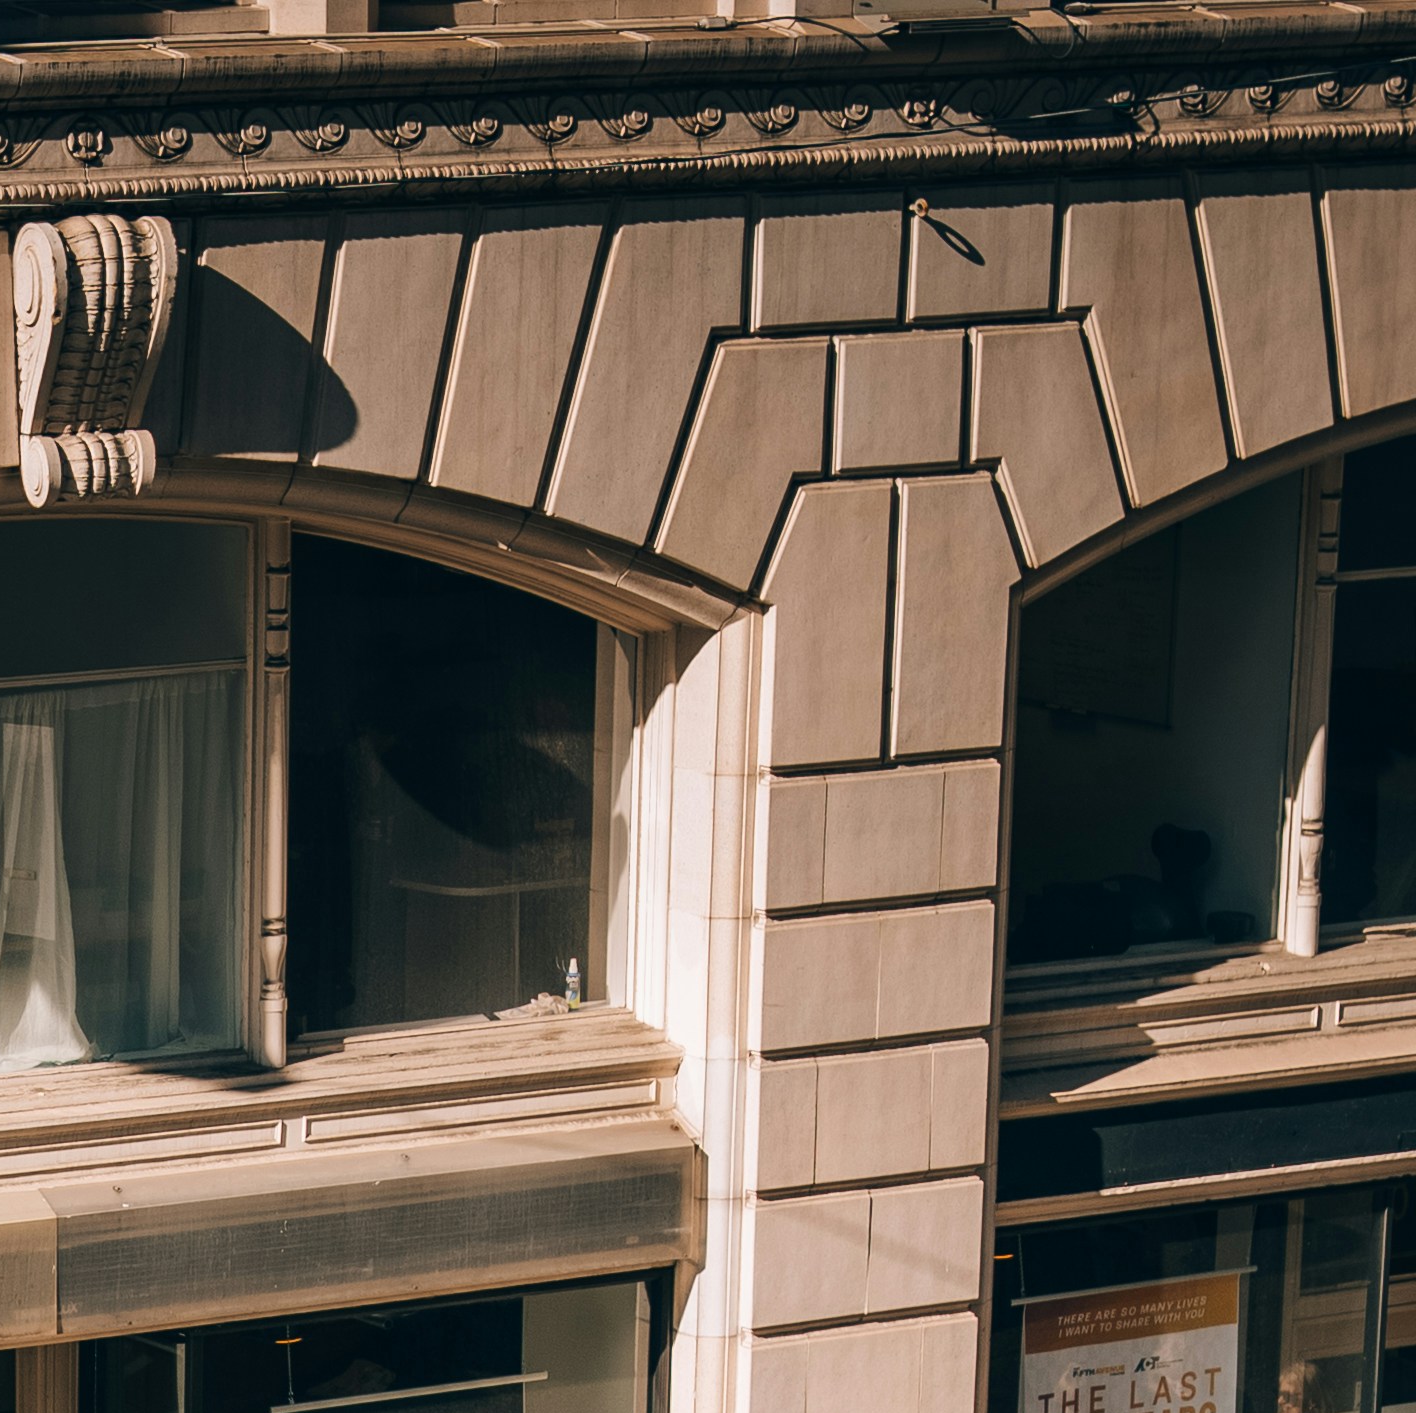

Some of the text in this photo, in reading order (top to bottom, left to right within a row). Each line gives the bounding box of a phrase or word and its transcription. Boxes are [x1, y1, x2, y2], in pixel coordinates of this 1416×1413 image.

[1058, 1312, 1091, 1326] THERE
[1094, 1309, 1116, 1320] ARE
[1140, 1301, 1173, 1315] MANY
[1176, 1296, 1208, 1310] LIVES
[1065, 1324, 1096, 1337] WANT
[1100, 1323, 1112, 1332] TO
[1116, 1317, 1150, 1330] SHARE
[1154, 1312, 1181, 1324] WITH
[1184, 1309, 1205, 1320] YOU
[1130, 1367, 1221, 1410] LAST
